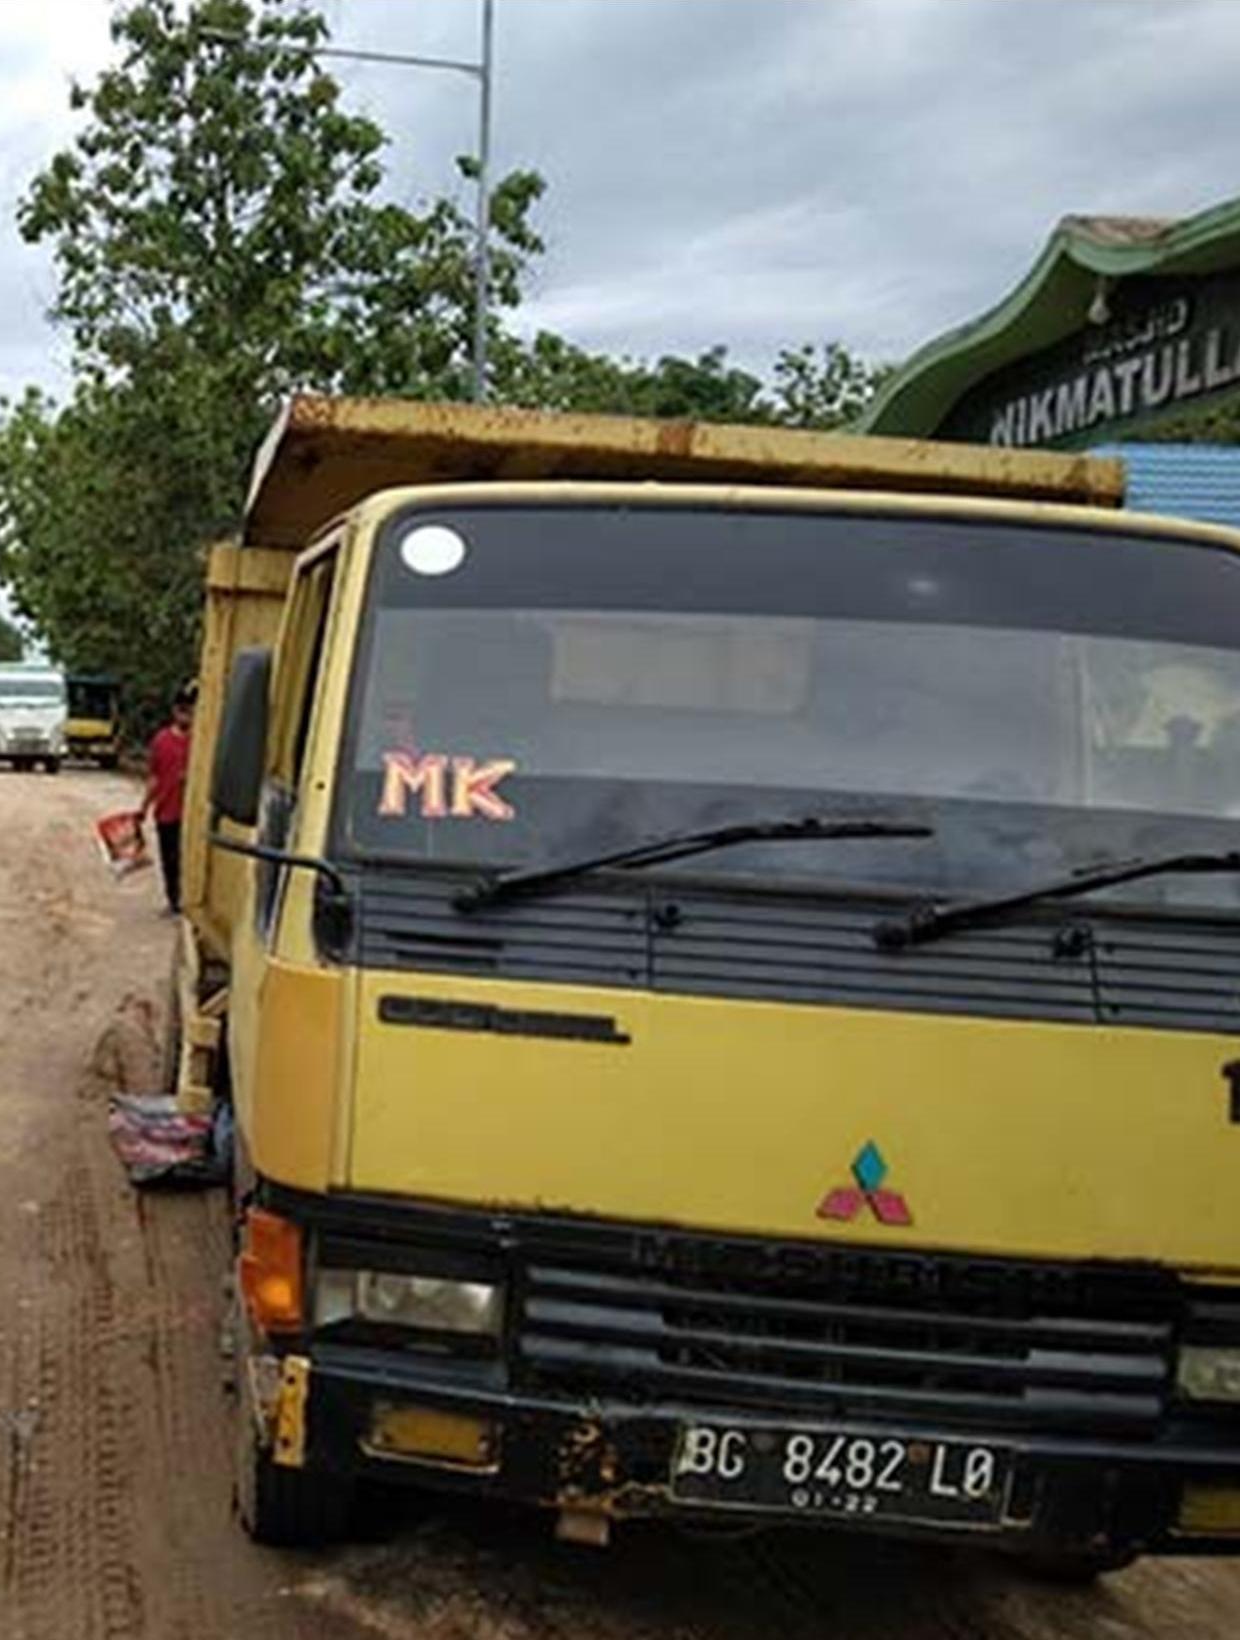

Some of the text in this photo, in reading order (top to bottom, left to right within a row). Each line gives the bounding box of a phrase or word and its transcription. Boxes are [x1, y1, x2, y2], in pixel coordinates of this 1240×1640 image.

[990, 329, 1240, 448] NIKMATULL
[378, 752, 517, 821] MK
[680, 1427, 746, 1478] BG
[782, 1434, 906, 1492] 8482
